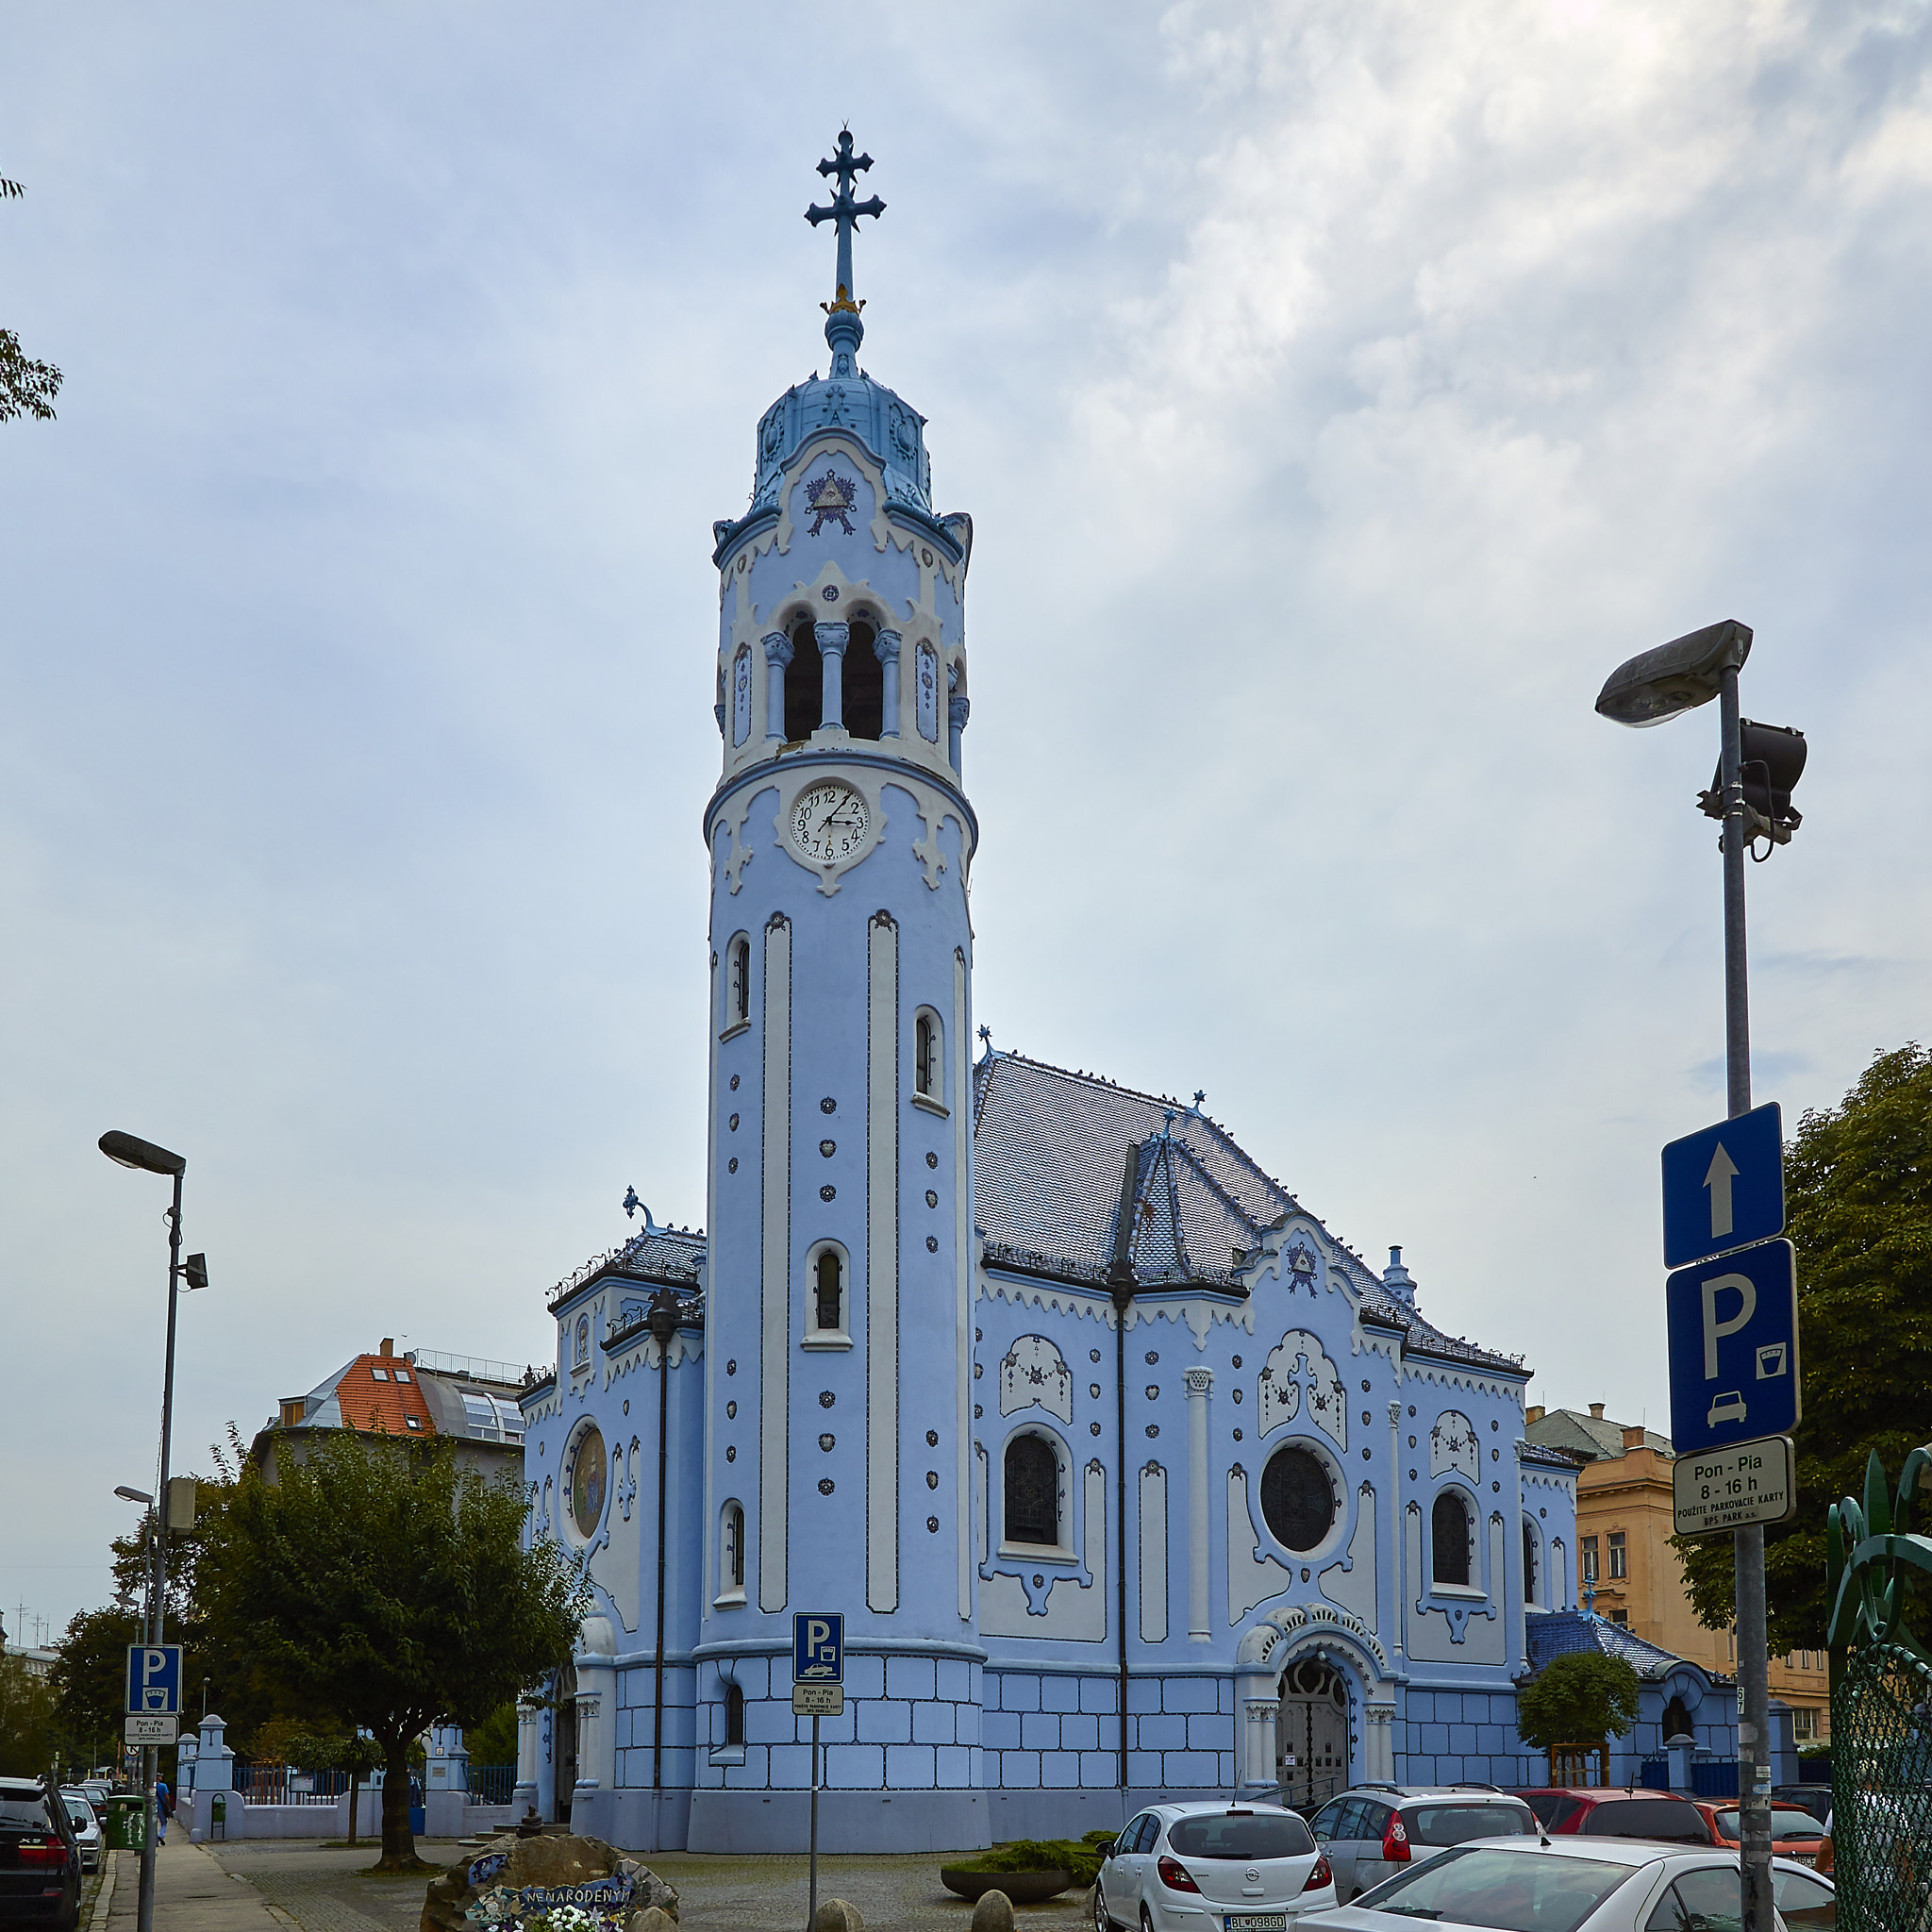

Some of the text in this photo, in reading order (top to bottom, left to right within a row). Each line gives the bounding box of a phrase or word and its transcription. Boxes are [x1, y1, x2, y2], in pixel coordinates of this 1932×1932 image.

[808, 794, 820, 808] 11
[823, 791, 836, 804] 12
[799, 807, 812, 821] 10
[851, 802, 859, 814] 2
[797, 819, 806, 831] 9
[857, 817, 864, 829] 3
[802, 831, 809, 843] 8
[851, 828, 860, 843] 4
[812, 840, 821, 852] 7
[824, 843, 834, 857] 6
[841, 839, 849, 851] 5
[1701, 1273, 1757, 1381] P
[1694, 1464, 1723, 1480] Pon
[1738, 1455, 1762, 1472] Pia
[1701, 1485, 1710, 1500] 8
[1725, 1478, 1741, 1494] 16
[1748, 1476, 1757, 1491] h
[1677, 1506, 1707, 1518] POUŽITE
[1757, 1491, 1784, 1504] KARTY
[1704, 1516, 1719, 1525] BPS
[1723, 1511, 1742, 1523] PARK
[808, 1620, 830, 1657] P
[142, 1649, 167, 1686] P
